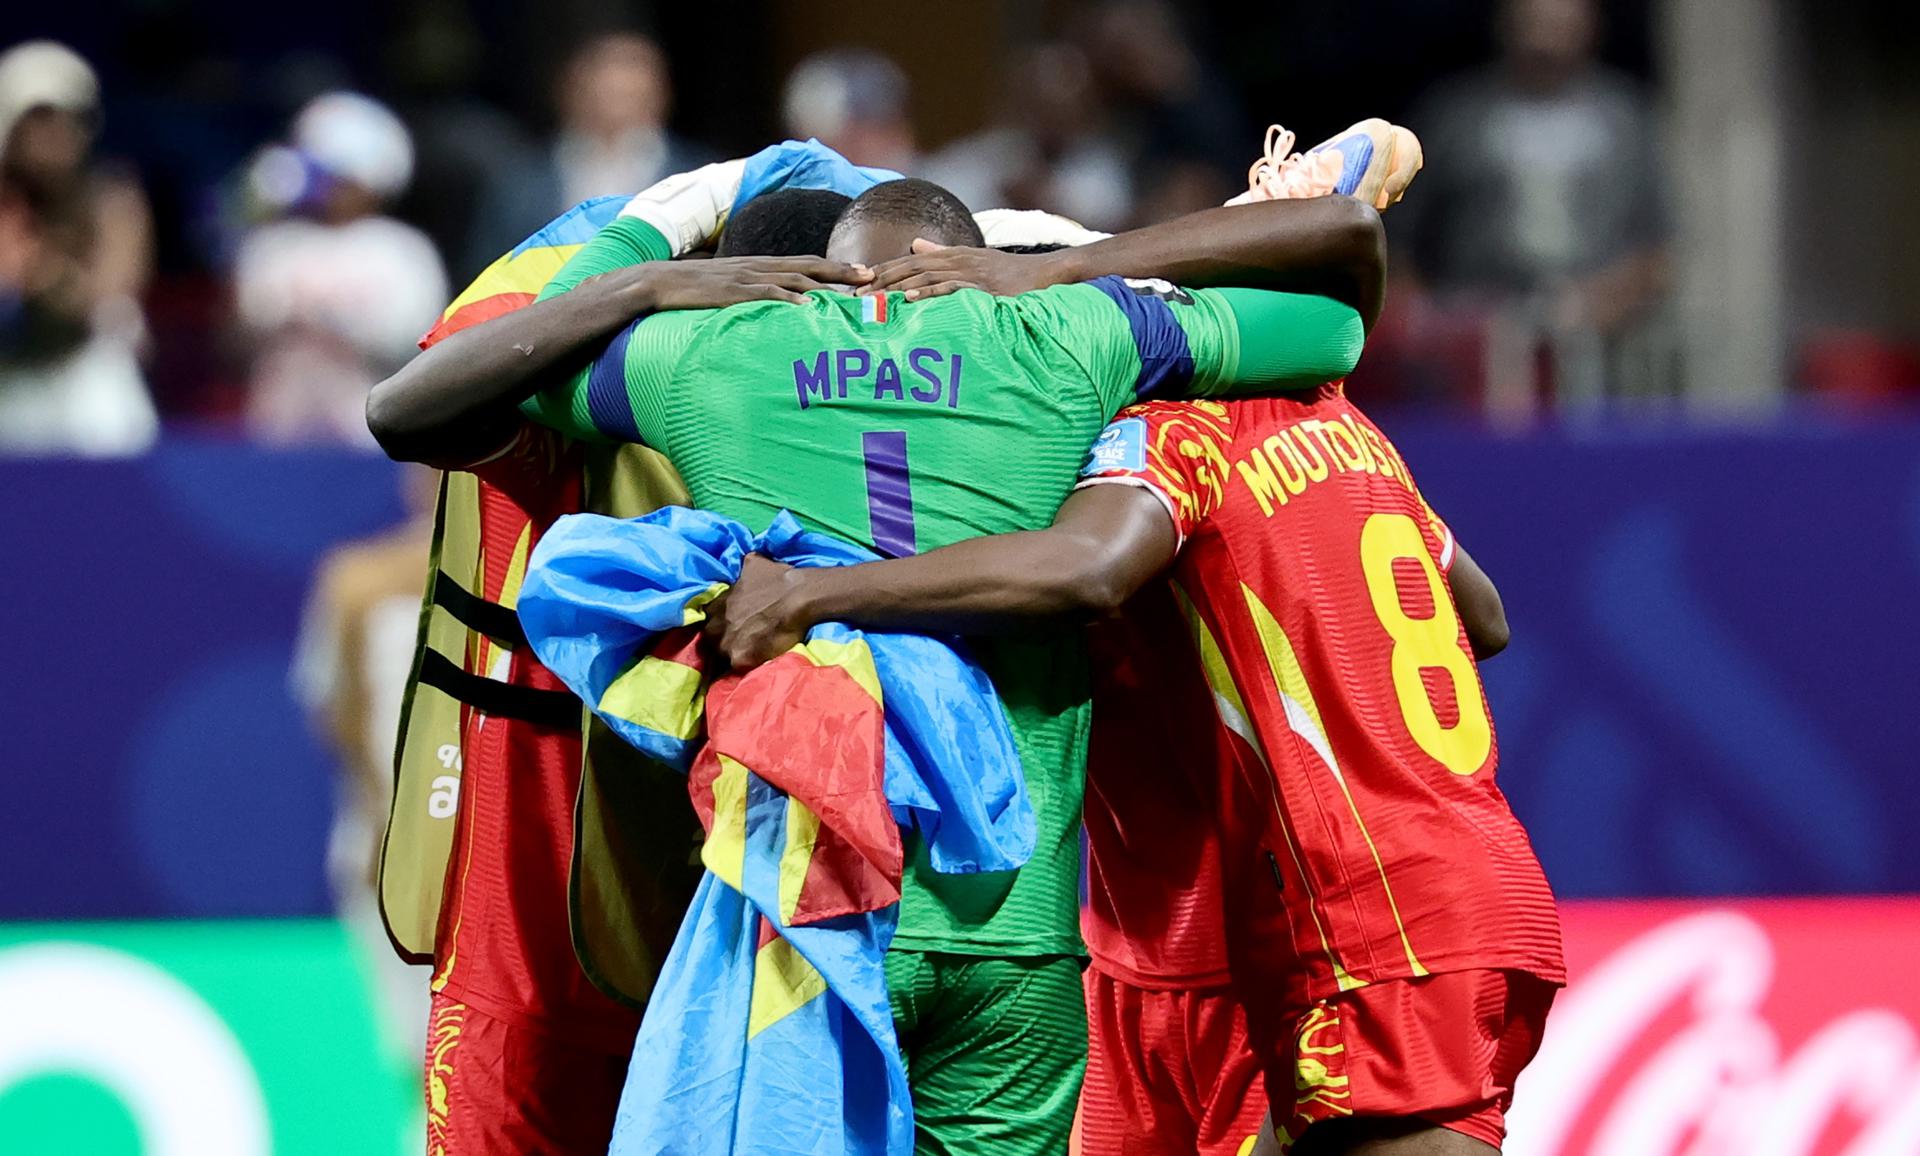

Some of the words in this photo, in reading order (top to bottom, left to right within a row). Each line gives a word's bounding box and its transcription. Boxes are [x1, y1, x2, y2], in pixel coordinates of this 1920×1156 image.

[793, 347, 961, 410] MPASI
[862, 430, 916, 558] 1
[1360, 513, 1492, 776] 8
